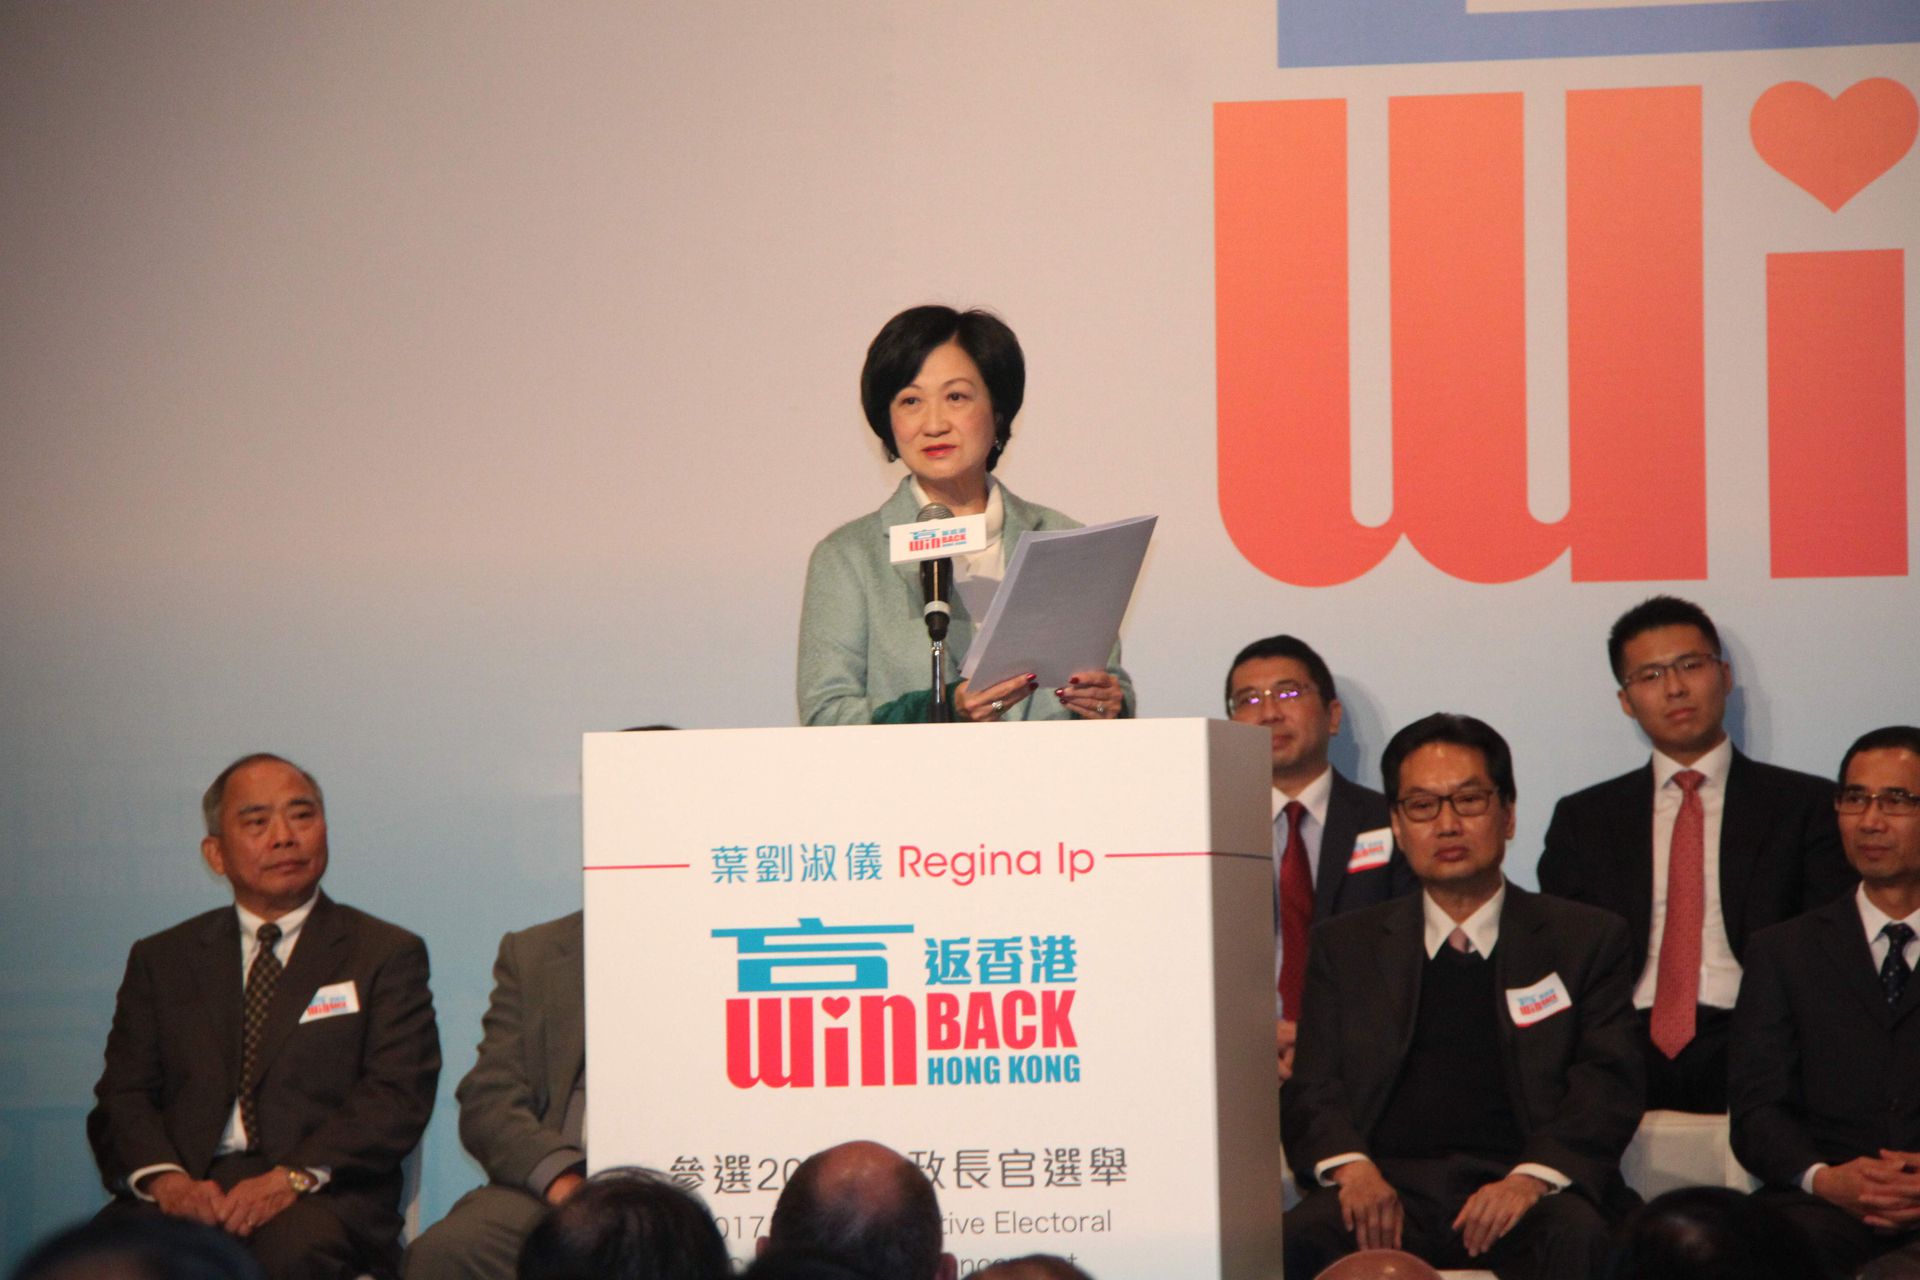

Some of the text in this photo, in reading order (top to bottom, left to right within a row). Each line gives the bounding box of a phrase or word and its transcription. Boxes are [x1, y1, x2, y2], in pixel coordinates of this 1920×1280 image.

[711, 842, 1095, 886] 葉劉淑儀 Regina Ip
[924, 935, 1078, 985] 返香港
[926, 989, 1078, 1051] BACK
[927, 1054, 1081, 1086] HONG KONG
[995, 1209, 1112, 1235] Electoral
